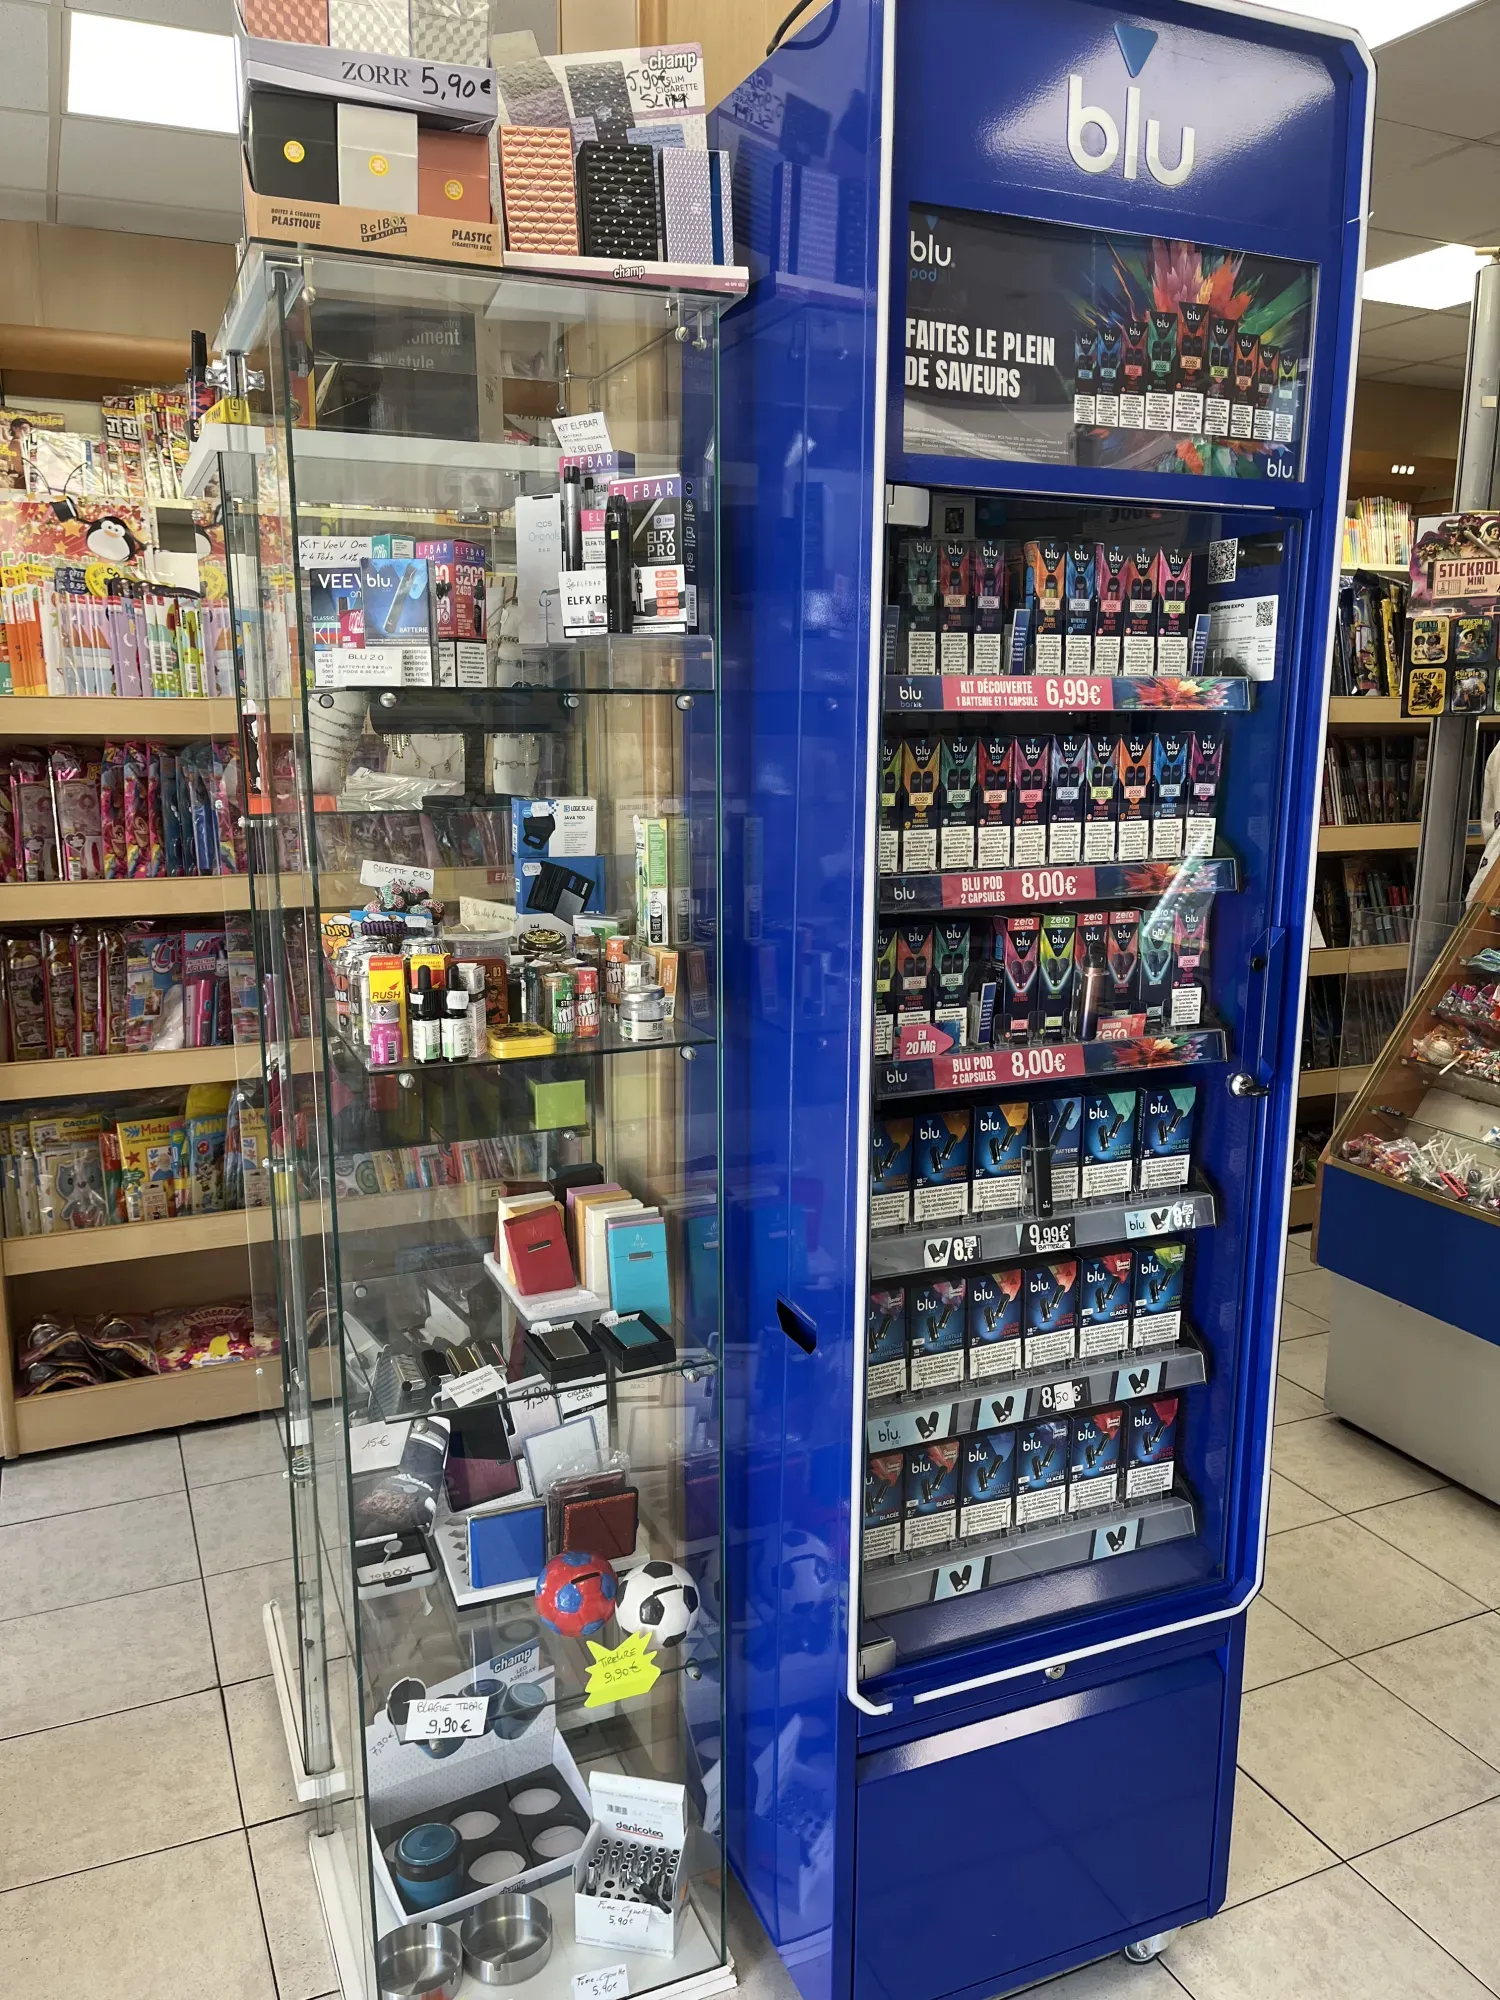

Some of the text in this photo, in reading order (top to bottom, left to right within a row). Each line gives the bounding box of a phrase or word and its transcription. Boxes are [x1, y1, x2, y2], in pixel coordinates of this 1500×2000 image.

[649, 51, 697, 73] champ
[342, 61, 409, 87] ZORR
[421, 66, 492, 100] 5,90€
[655, 84, 698, 94] CIGARETTE
[1066, 74, 1195, 186] blu
[271, 216, 321, 230] PLASTIQUE
[451, 229, 492, 244] PLASTIC
[910, 230, 952, 267] blu
[613, 265, 645, 279] champ
[910, 268, 937, 282] pod
[1187, 310, 1200, 321] blu
[1216, 324, 1228, 335] blu
[905, 318, 1055, 367] FAITES LE PLEIN
[1105, 332, 1115, 342] blu
[1241, 338, 1251, 348] blu
[1284, 359, 1293, 367] blu
[905, 355, 1020, 398] DE SAVEURS
[570, 418, 599, 430] ELFBAR
[588, 444, 602, 452] EUR
[1267, 459, 1293, 478] blu
[647, 530, 675, 543] ELFX
[300, 539, 319, 548] Kit
[455, 547, 485, 556] ELFBAR
[647, 543, 676, 557] PRO
[948, 545, 963, 555] blu
[1045, 549, 1059, 559] blu
[1109, 552, 1123, 562] blu
[1170, 555, 1183, 564] blu
[366, 573, 390, 588] blu
[1467, 576, 1485, 586] MINI
[567, 596, 592, 605] ELFX
[313, 623, 341, 645] KIT
[399, 626, 428, 634] BATTERIE
[1412, 671, 1437, 680] AK-47
[960, 678, 1032, 694] KIT DÉCOUVERTE
[899, 686, 922, 700] blu
[961, 697, 992, 706] BATTERIE
[994, 697, 1002, 706] ET
[1009, 696, 1038, 707] CAPSULE
[990, 744, 1004, 754] blu
[1064, 742, 1077, 751] blu
[1130, 742, 1143, 751] blu
[1203, 740, 1215, 749] blu
[916, 746, 930, 756] blu
[373, 863, 407, 875] SUCETTE
[961, 875, 1003, 891] BLU POD
[1021, 870, 1077, 900] 8,00€
[894, 887, 915, 900] blu
[961, 891, 1005, 904] 2 CAPSULES
[1050, 916, 1070, 924] zero
[1084, 913, 1103, 921] zero
[1116, 911, 1134, 919] zero
[1014, 918, 1034, 926] zero
[326, 924, 351, 936] DRY
[1152, 928, 1165, 937] blu
[908, 932, 924, 942] blu
[1086, 932, 1099, 941] blu
[1016, 938, 1030, 947] blu
[372, 991, 400, 1000] RUSH
[917, 1030, 926, 1040] EN
[906, 1041, 936, 1054] 20 MG
[952, 1055, 993, 1072] BLU POD
[1011, 1048, 1066, 1079] 8,00€
[886, 1070, 907, 1084] blu
[952, 1071, 996, 1085] 2 CAPSULES
[1089, 1107, 1108, 1119] blu
[1150, 1103, 1168, 1114] blu
[62, 1119, 100, 1128] CADEAU
[980, 1119, 999, 1132] blu
[920, 1128, 940, 1140] blu
[1129, 1219, 1145, 1231] blu
[1141, 1263, 1159, 1274] blu
[1087, 1271, 1105, 1282] blu
[1030, 1281, 1048, 1292] blu
[974, 1289, 993, 1302] blu
[917, 1299, 936, 1311] blu
[1110, 1308, 1128, 1317] GLACÉE
[576, 1392, 593, 1401] CASE
[1134, 1416, 1151, 1427] blu
[878, 1429, 899, 1442] blu
[1078, 1429, 1095, 1440] blu
[1023, 1439, 1041, 1451] blu
[968, 1450, 987, 1462] blu
[912, 1462, 931, 1474] blu
[1099, 1464, 1117, 1472] GLACÉE
[1046, 1474, 1064, 1483] GLACÉE
[936, 1498, 956, 1507] GLACÉE
[880, 1511, 900, 1520] GLACÉE
[382, 1564, 413, 1579] BOX
[493, 1648, 532, 1673] champ
[509, 1665, 537, 1683] ASHTRAY
[515, 1665, 528, 1674] LED
[416, 1701, 484, 1712] BLAGUE TABAC
[425, 1719, 473, 1736] 9,90€
[616, 1821, 664, 1838] denicotea
